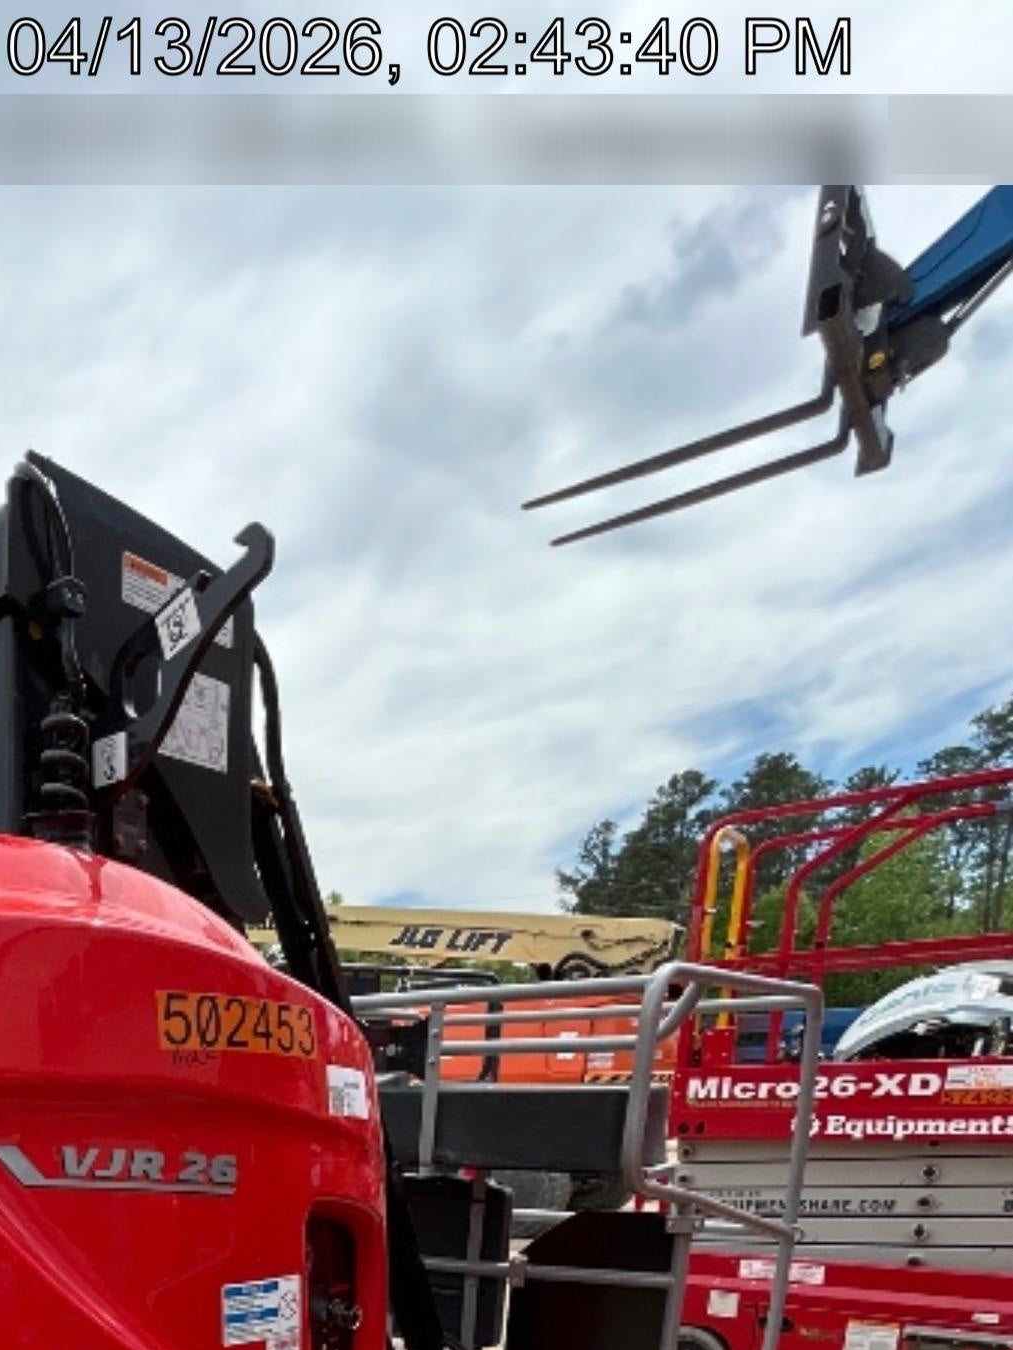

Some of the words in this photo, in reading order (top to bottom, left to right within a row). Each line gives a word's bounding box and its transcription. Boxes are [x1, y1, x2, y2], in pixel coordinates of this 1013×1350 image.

[388, 925, 444, 949] JLG
[446, 929, 513, 955] LIFT
[163, 992, 316, 1057] 502453
[61, 1145, 166, 1181] VJR
[178, 1151, 237, 1184] 26
